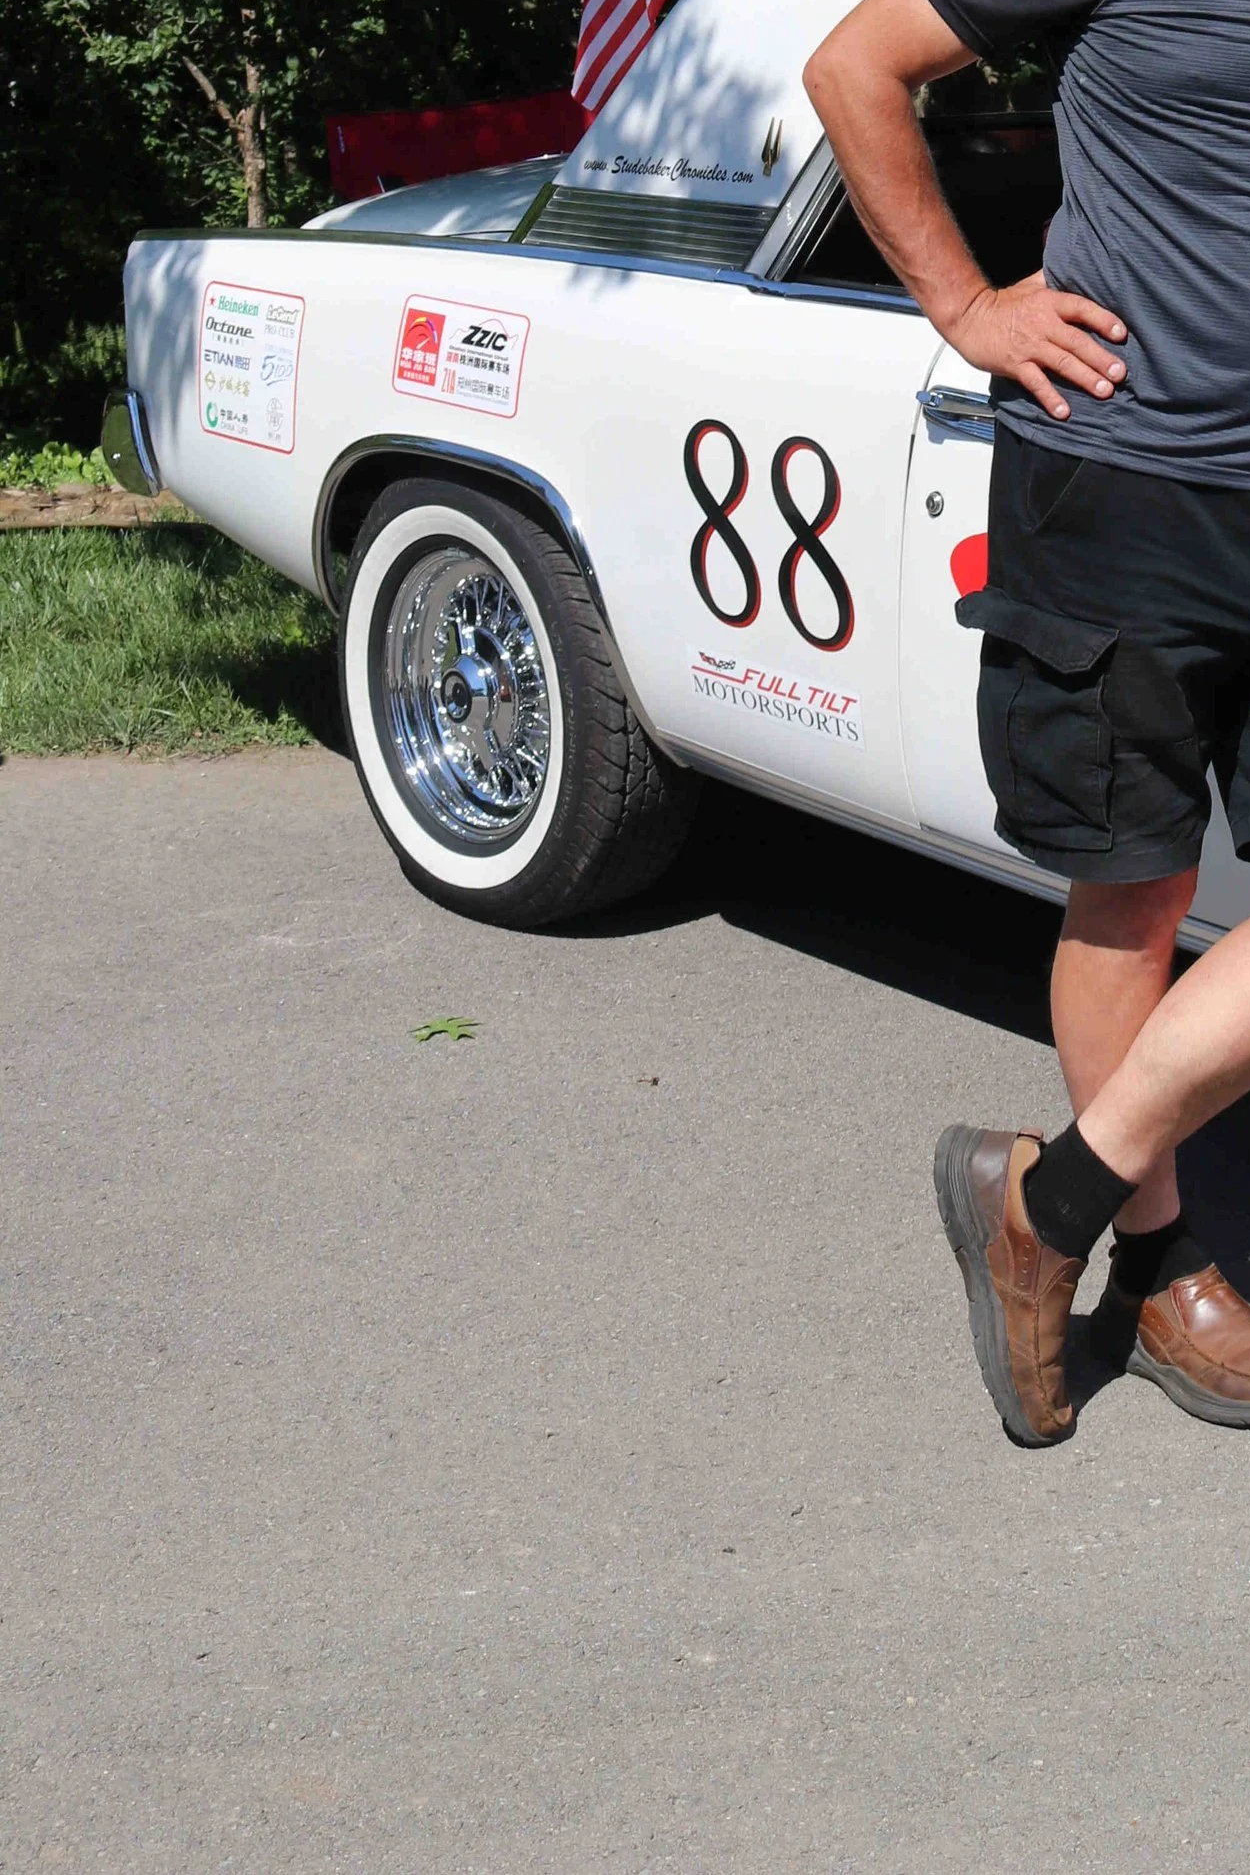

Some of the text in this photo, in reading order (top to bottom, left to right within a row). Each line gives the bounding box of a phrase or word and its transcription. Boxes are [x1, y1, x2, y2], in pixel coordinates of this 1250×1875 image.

[217, 295, 260, 317] Heineken
[206, 316, 254, 339] Octane
[461, 325, 508, 352] ZZIC
[684, 419, 855, 652] 88
[694, 675, 860, 742] MOTORSPORTS
[742, 668, 858, 715] FULL TILT
